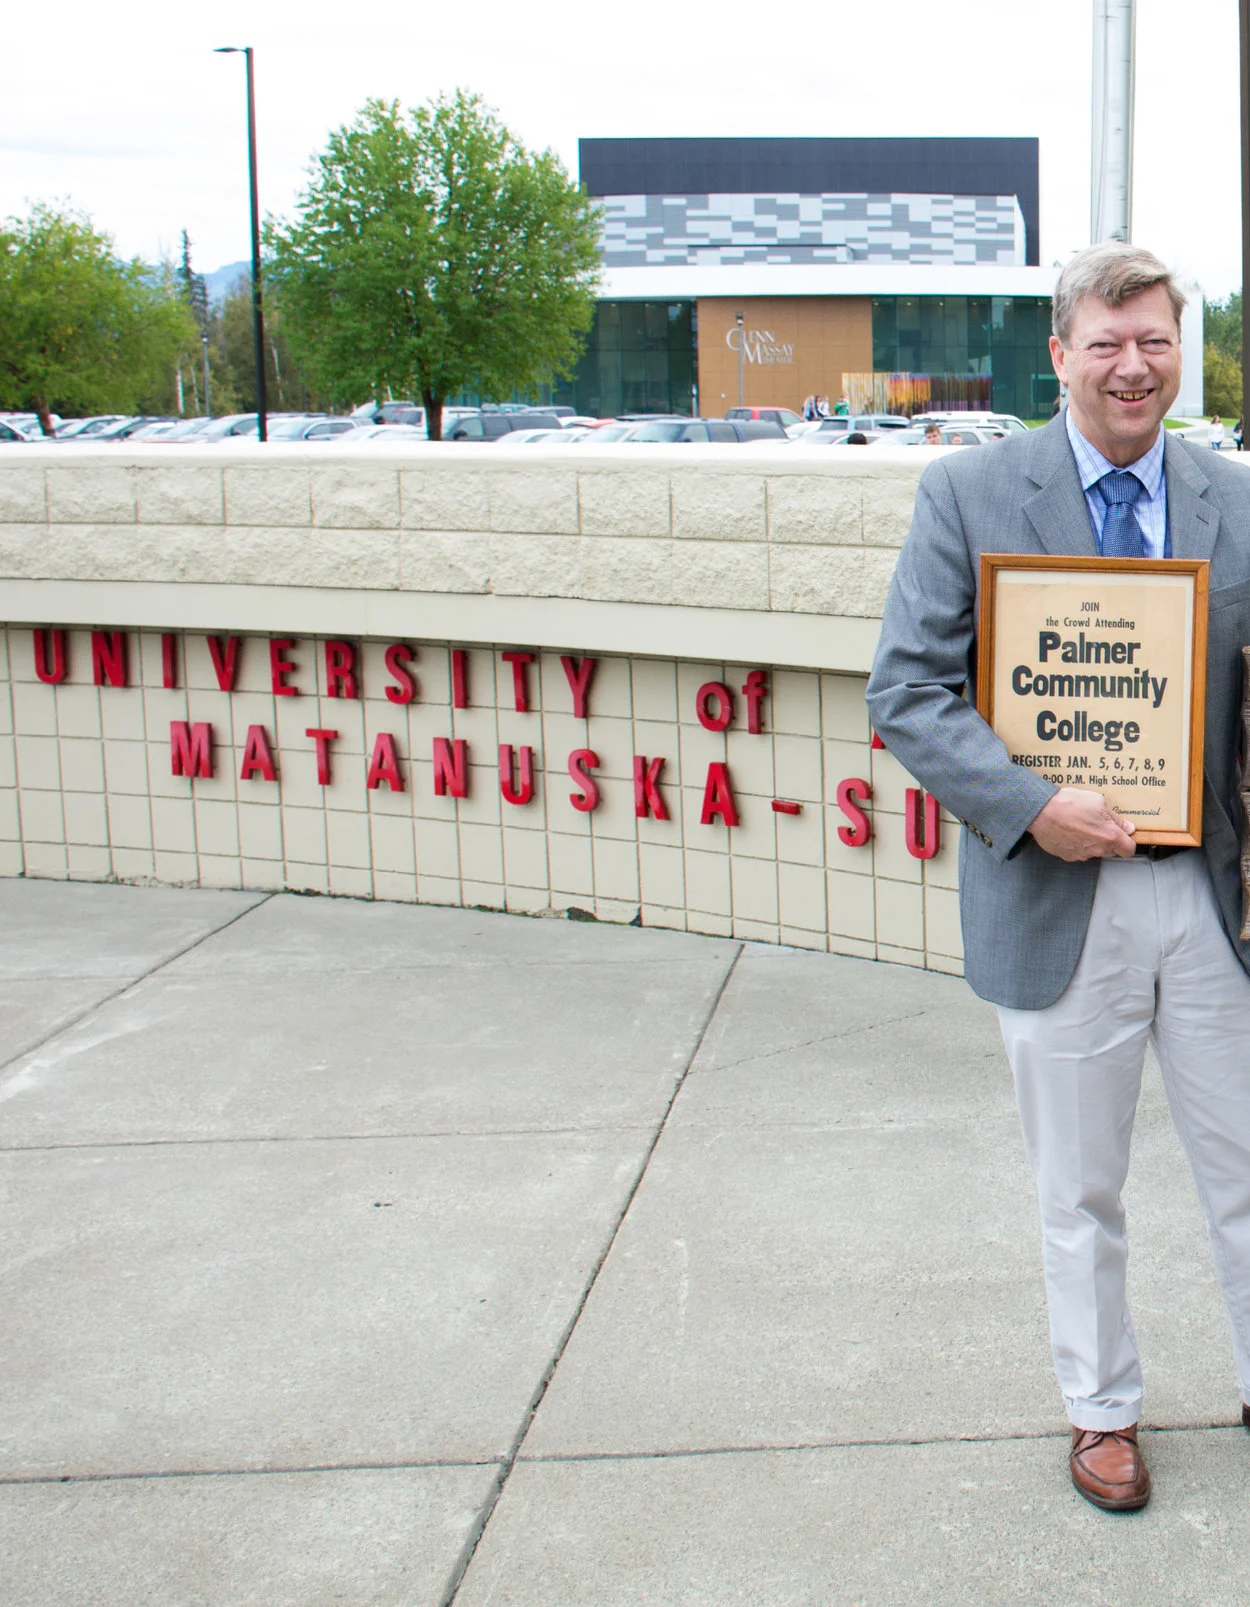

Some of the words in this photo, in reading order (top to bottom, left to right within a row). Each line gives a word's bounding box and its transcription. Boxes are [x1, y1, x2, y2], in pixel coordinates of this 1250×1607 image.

[1046, 616, 1059, 627] the
[1063, 616, 1090, 628] Crowd
[1095, 618, 1135, 630] Attending
[1080, 601, 1100, 612] JOIN
[1039, 631, 1141, 664] Palmer
[33, 628, 598, 719] UNIVERSITY
[1012, 665, 1168, 708] Community
[1036, 710, 1141, 751] College
[1012, 754, 1062, 769] REGISTER
[1067, 756, 1092, 769] JAN.
[1099, 756, 1109, 771] 5,
[1114, 757, 1124, 772] 6,
[1129, 757, 1139, 772] 7,
[1144, 758, 1154, 773] 8,
[1158, 758, 1166, 771] 9
[170, 720, 942, 860] MATANUSKA-SU
[1066, 774, 1086, 785] P.M.
[1089, 775, 1108, 787] High
[1112, 775, 1138, 786] School
[1142, 776, 1166, 787] Office
